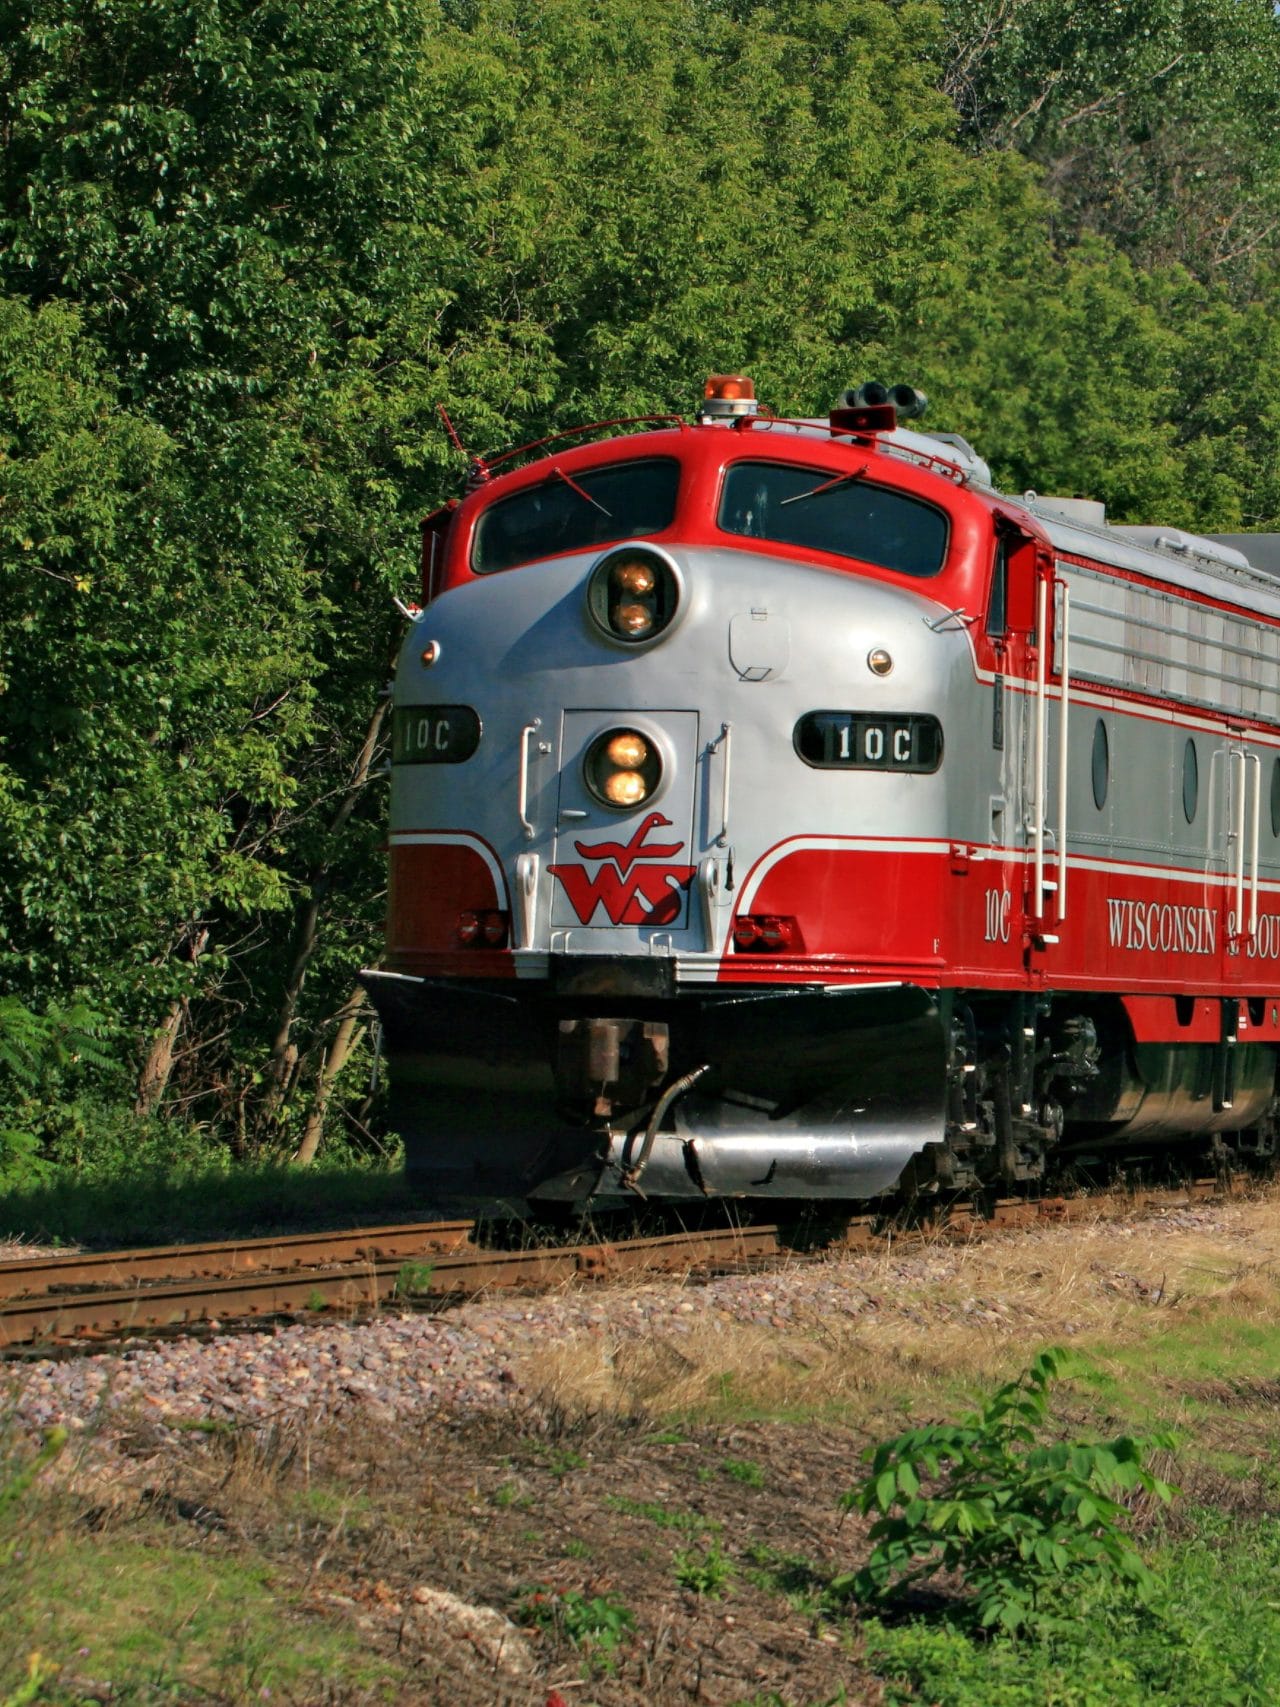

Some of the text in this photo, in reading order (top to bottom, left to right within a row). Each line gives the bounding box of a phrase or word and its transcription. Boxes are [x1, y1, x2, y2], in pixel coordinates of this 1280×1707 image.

[405, 719, 450, 751] 10C
[840, 727, 910, 761] 10C
[546, 863, 697, 925] WS
[985, 889, 1011, 943] 10C
[1107, 898, 1217, 954] WISCONSIN
[1226, 910, 1240, 956] &
